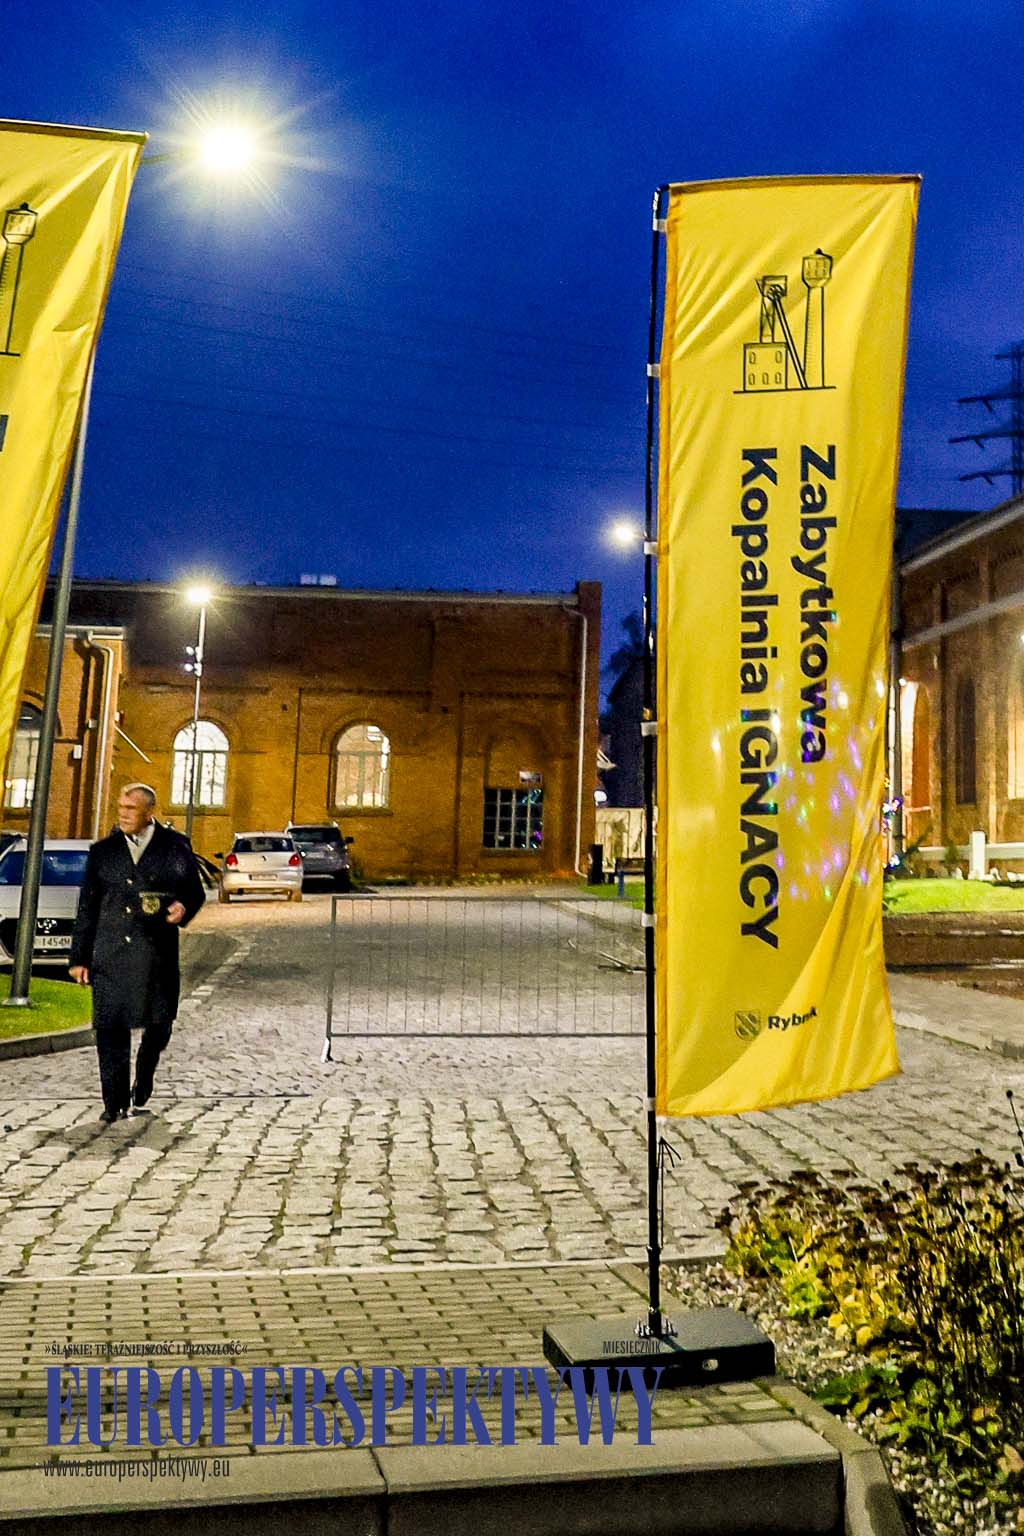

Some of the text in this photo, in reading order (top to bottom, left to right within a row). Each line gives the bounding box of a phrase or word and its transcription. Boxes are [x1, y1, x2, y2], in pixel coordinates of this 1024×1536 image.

[731, 447, 779, 950] Kopalnia IGNACY
[791, 444, 838, 764] Zabytkowa
